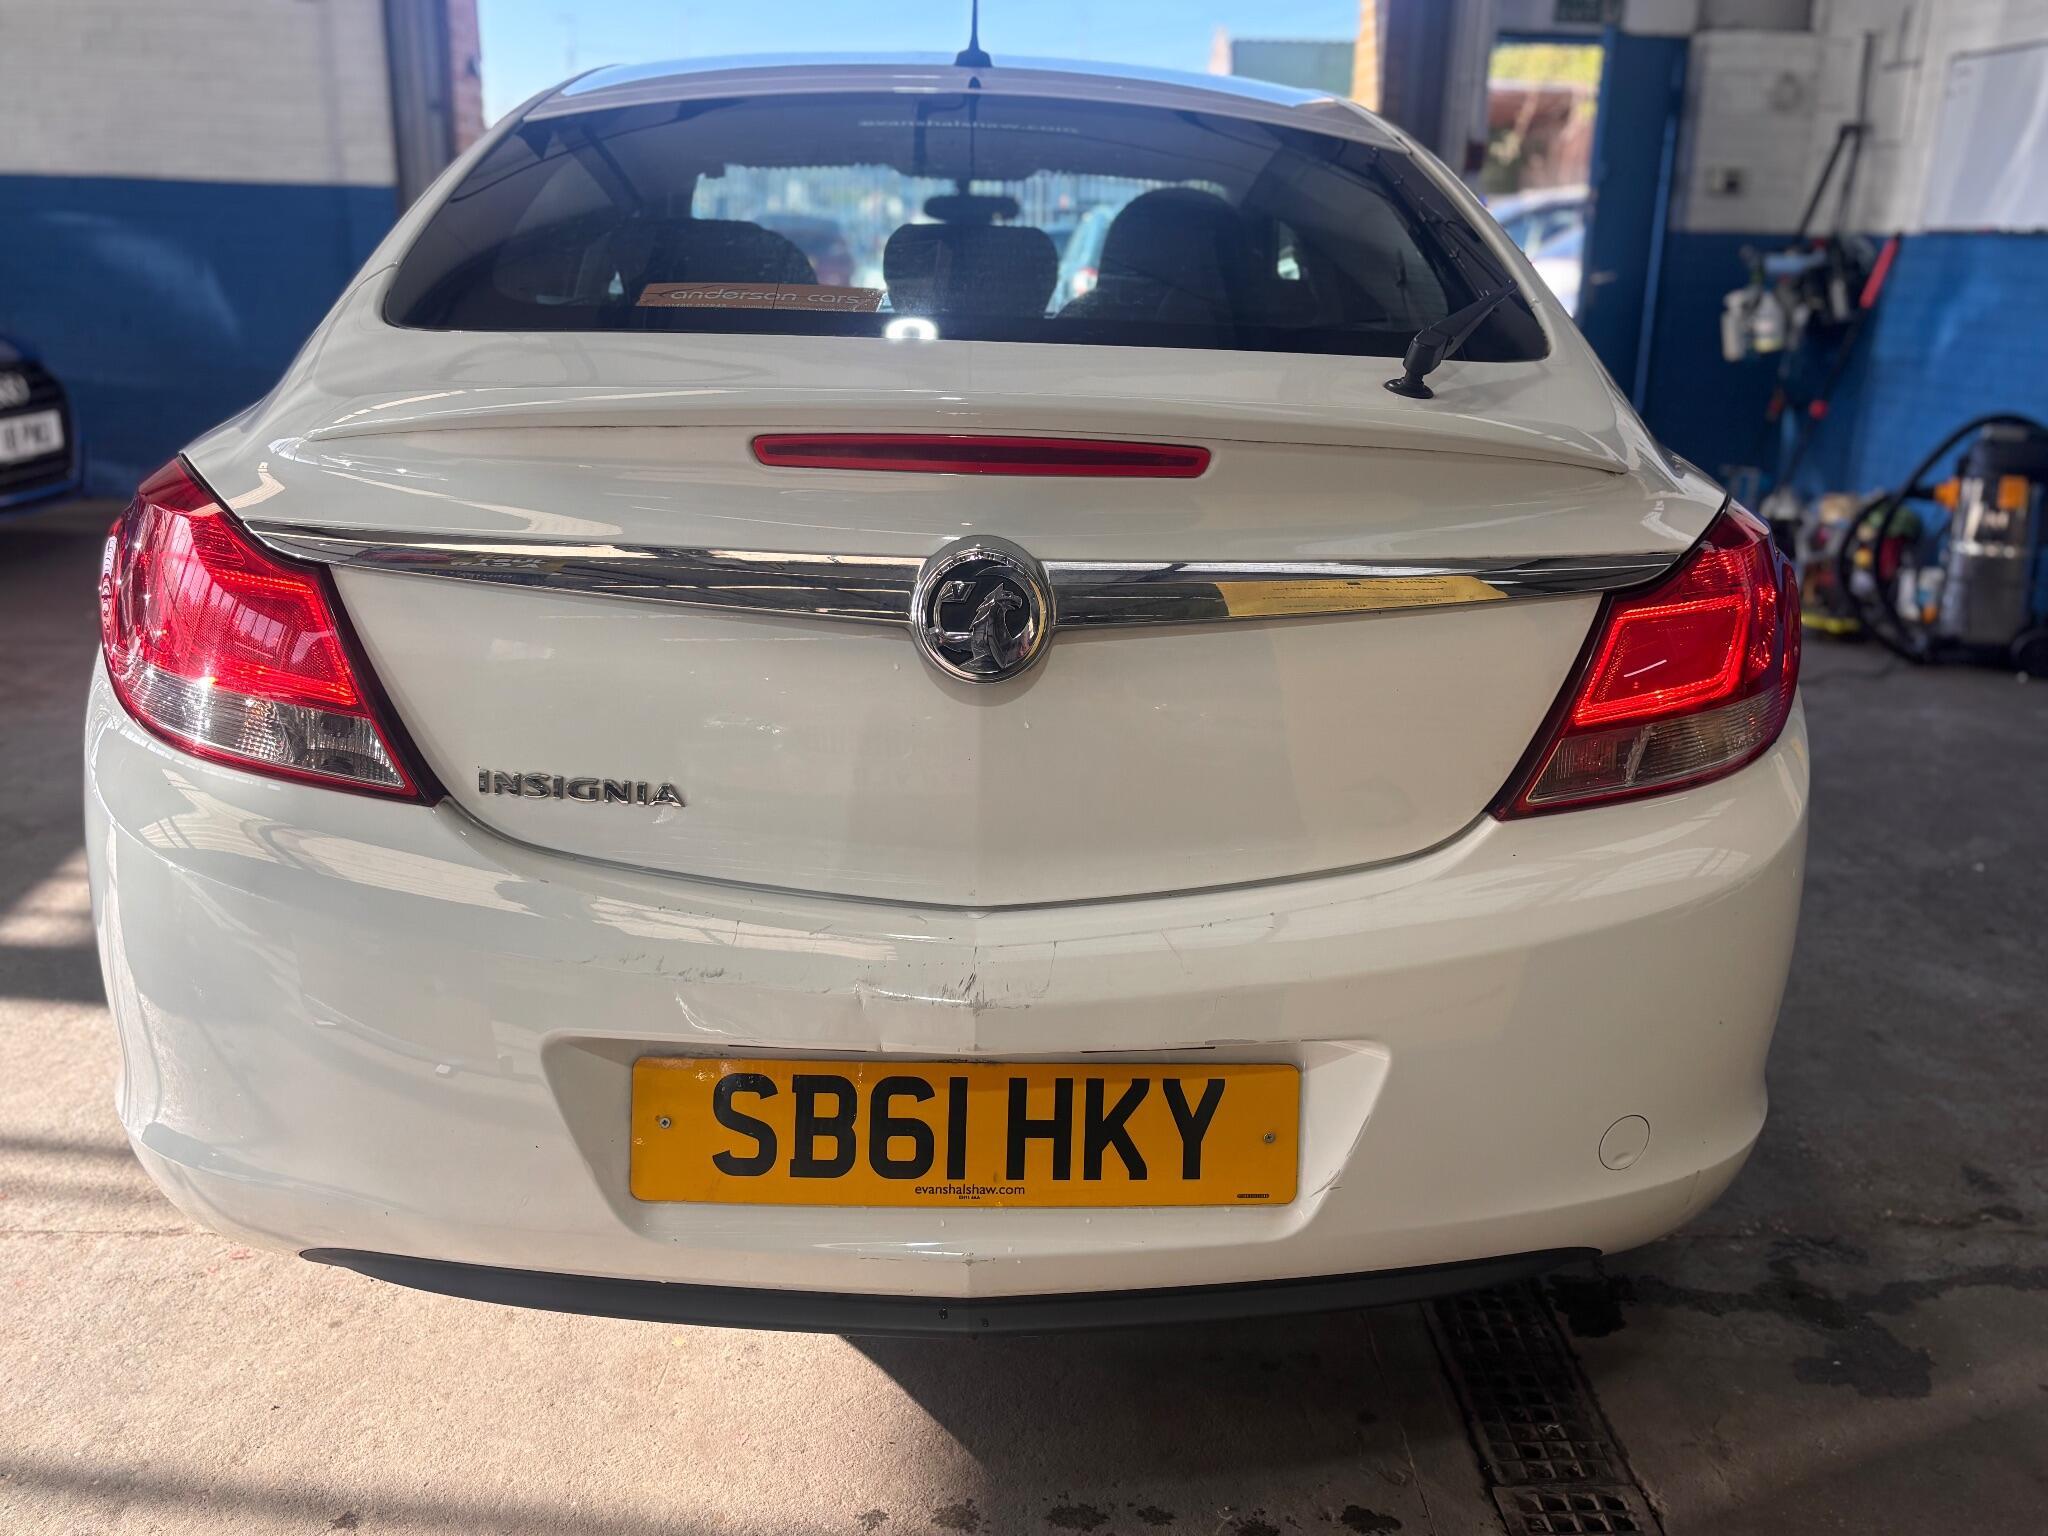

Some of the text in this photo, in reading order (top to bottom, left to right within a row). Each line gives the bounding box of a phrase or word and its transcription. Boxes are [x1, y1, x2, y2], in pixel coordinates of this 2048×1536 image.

[670, 288, 860, 304] anderson cars
[478, 769, 685, 807] INSIGNIA
[711, 1073, 1226, 1181] SB61 HKY
[914, 1183, 1025, 1195] evanshalshaw.com
